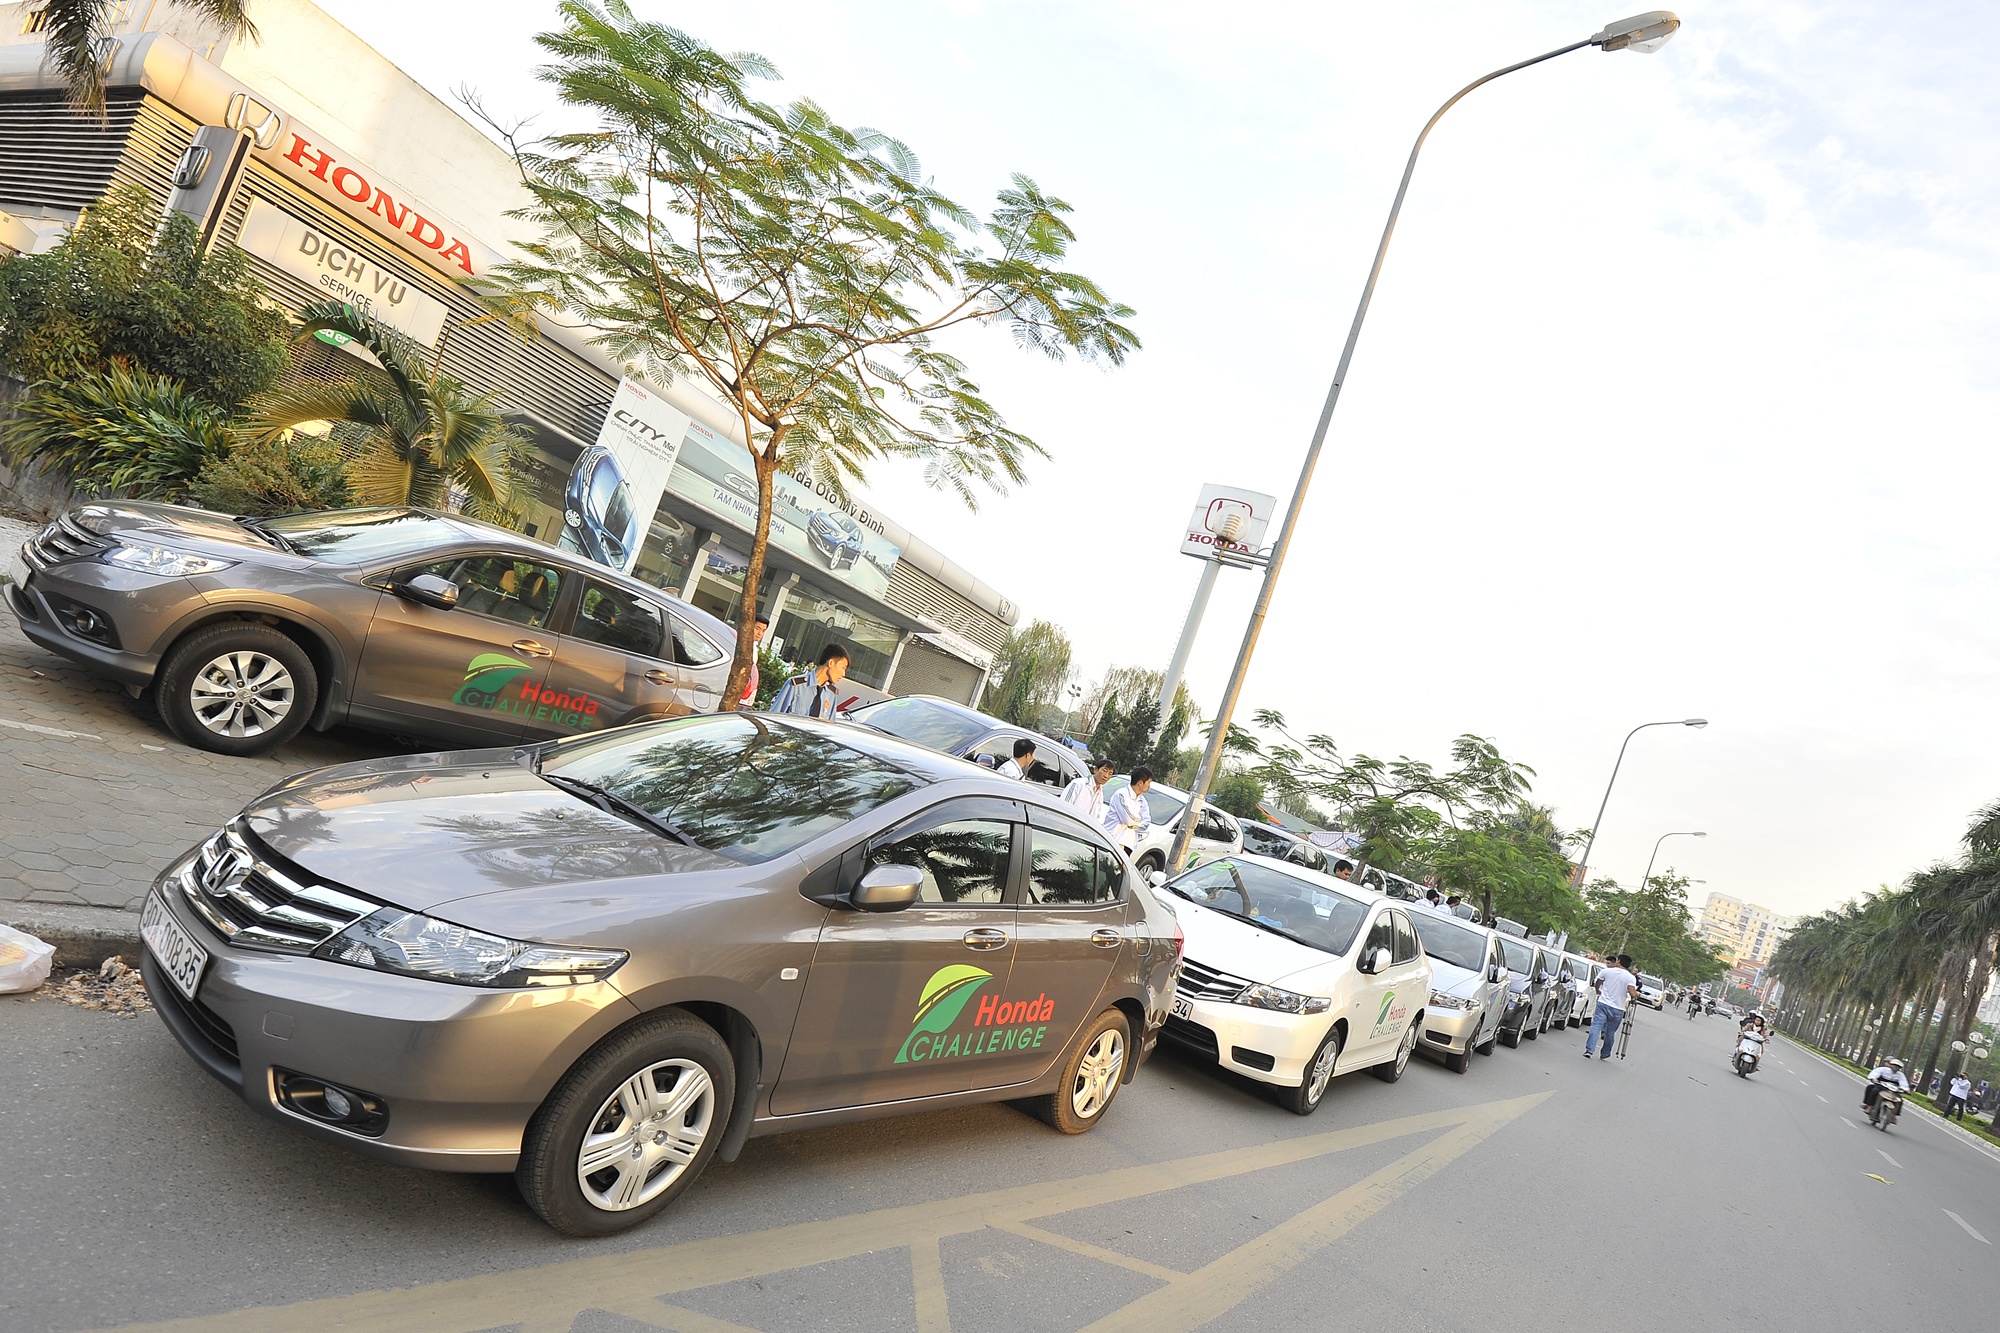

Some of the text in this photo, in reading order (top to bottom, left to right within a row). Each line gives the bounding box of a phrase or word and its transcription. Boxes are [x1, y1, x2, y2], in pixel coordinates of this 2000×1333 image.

[283, 132, 475, 275] HONDA
[299, 230, 407, 307] DỊCH VỤ
[319, 274, 373, 310] SERVICE
[624, 382, 647, 400] HONDA
[614, 409, 666, 441] CITY
[690, 421, 714, 439] HONDA
[465, 691, 594, 730] CHALLENGE
[520, 680, 599, 715] Honda
[974, 992, 1055, 1027] Honda
[911, 1026, 1048, 1062] CHALLENGE
